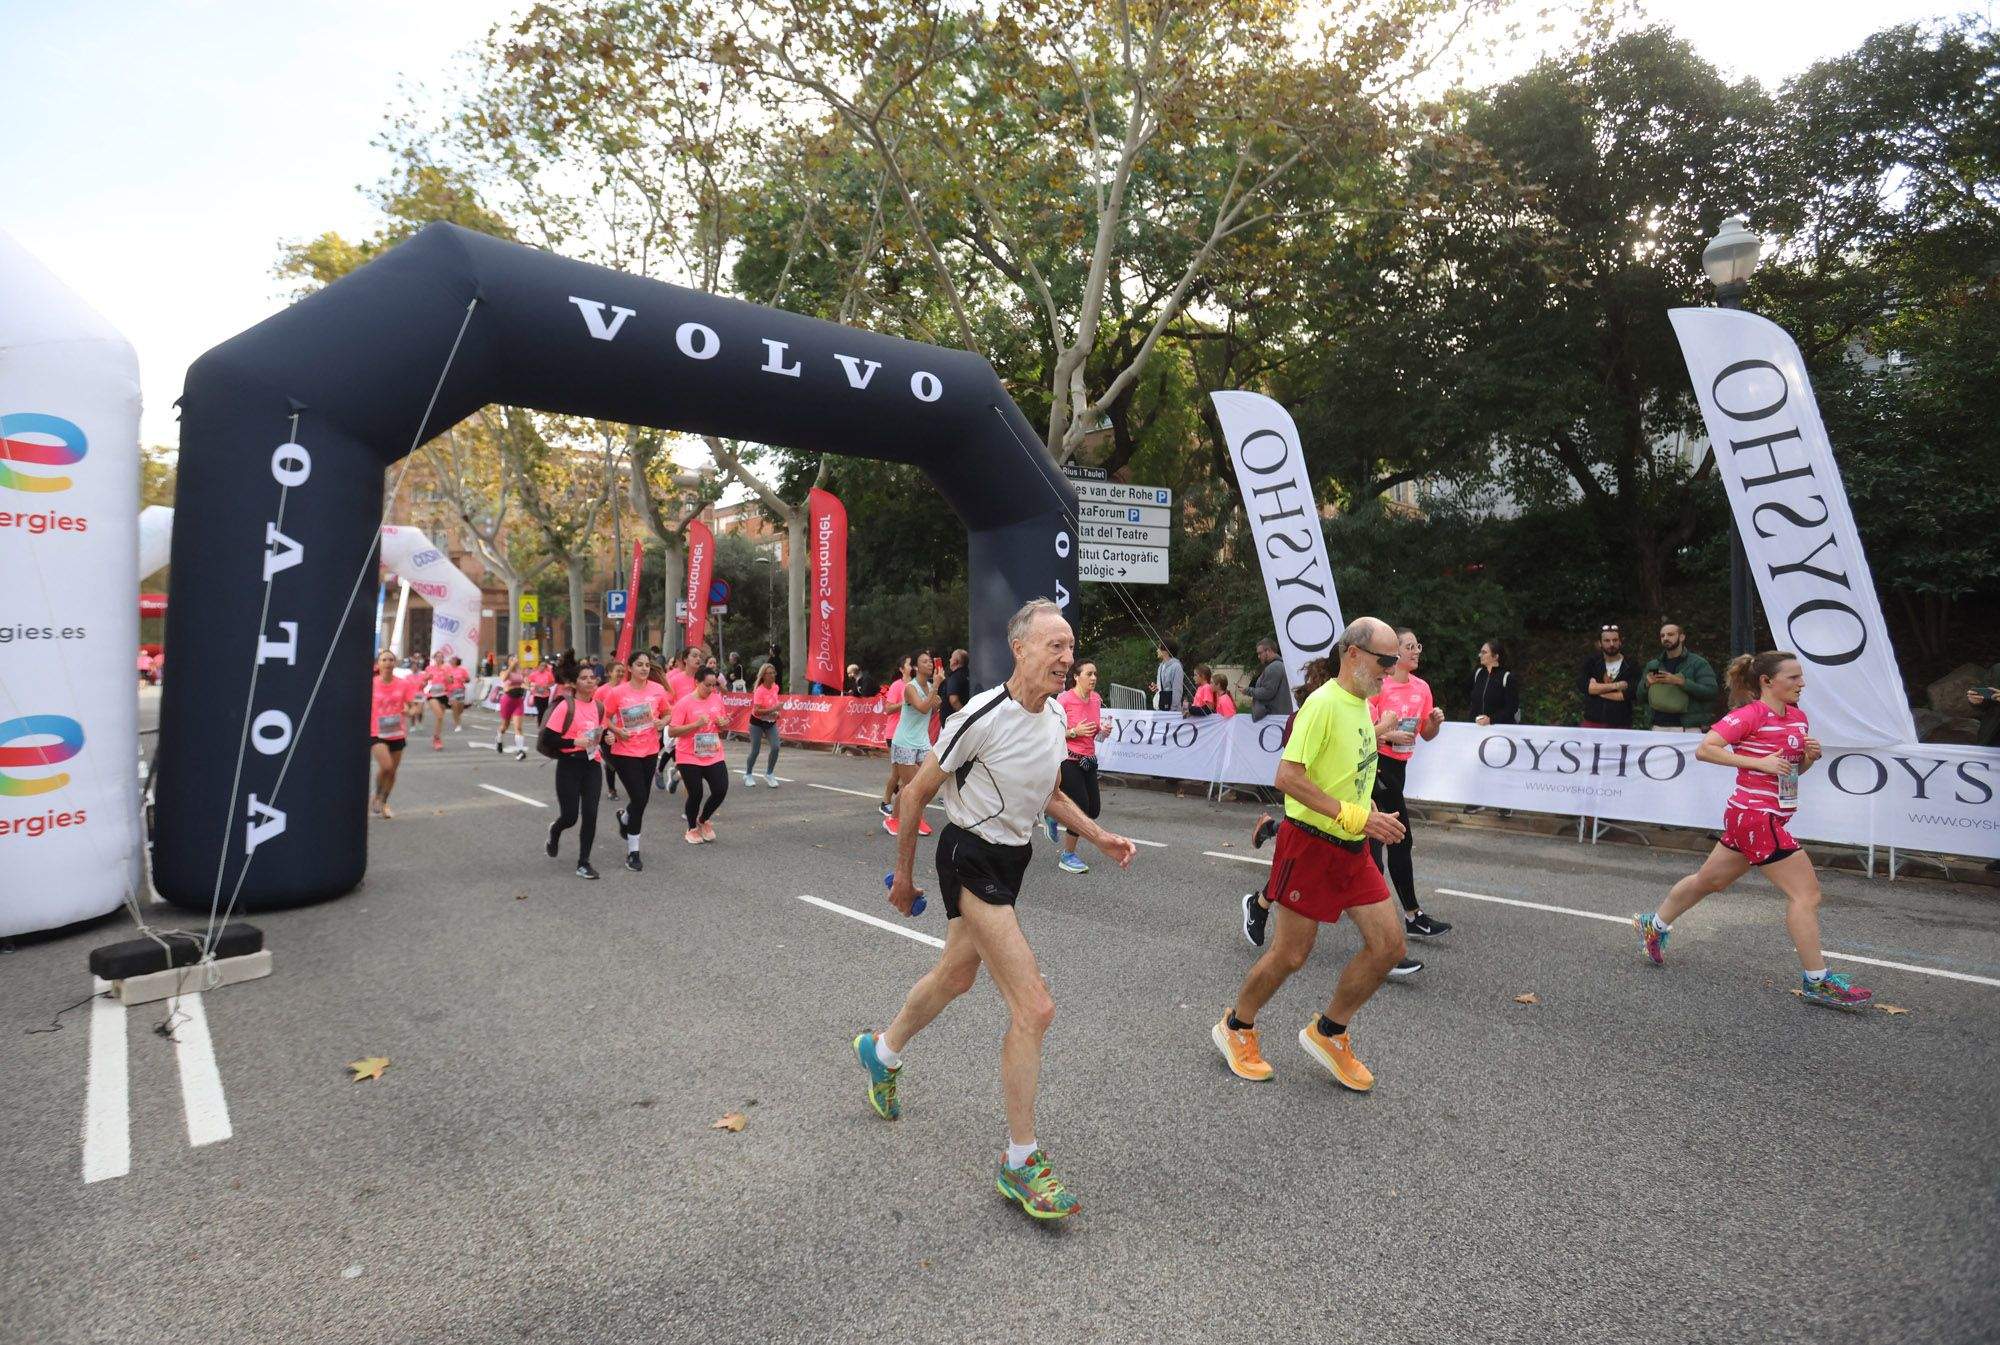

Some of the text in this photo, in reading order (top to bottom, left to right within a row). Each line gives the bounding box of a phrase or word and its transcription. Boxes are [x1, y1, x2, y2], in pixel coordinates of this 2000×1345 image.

[568, 296, 943, 402] VOLVO
[1083, 469, 1105, 479] Taulet
[1090, 486, 1107, 497] van
[1110, 486, 1126, 499] der
[1129, 488, 1153, 501] Rohe
[1080, 505, 1125, 519] xaForum
[0, 510, 88, 534] ergies
[1098, 526, 1112, 538] del
[1116, 527, 1148, 541] Teatre
[1103, 549, 1159, 565] Cartogràfic
[1079, 563, 1114, 579] eològic
[0, 623, 86, 643] gies.es
[245, 442, 312, 854] VOLVO
[792, 698, 832, 713] Santander
[846, 699, 873, 715] Sports
[1114, 718, 1199, 749] YSHO
[1478, 735, 1686, 781] OYSHO
[1827, 753, 1993, 805] OYS
[1525, 781, 1622, 798] WWW.OYSHO.COM
[0, 808, 87, 837] ergies
